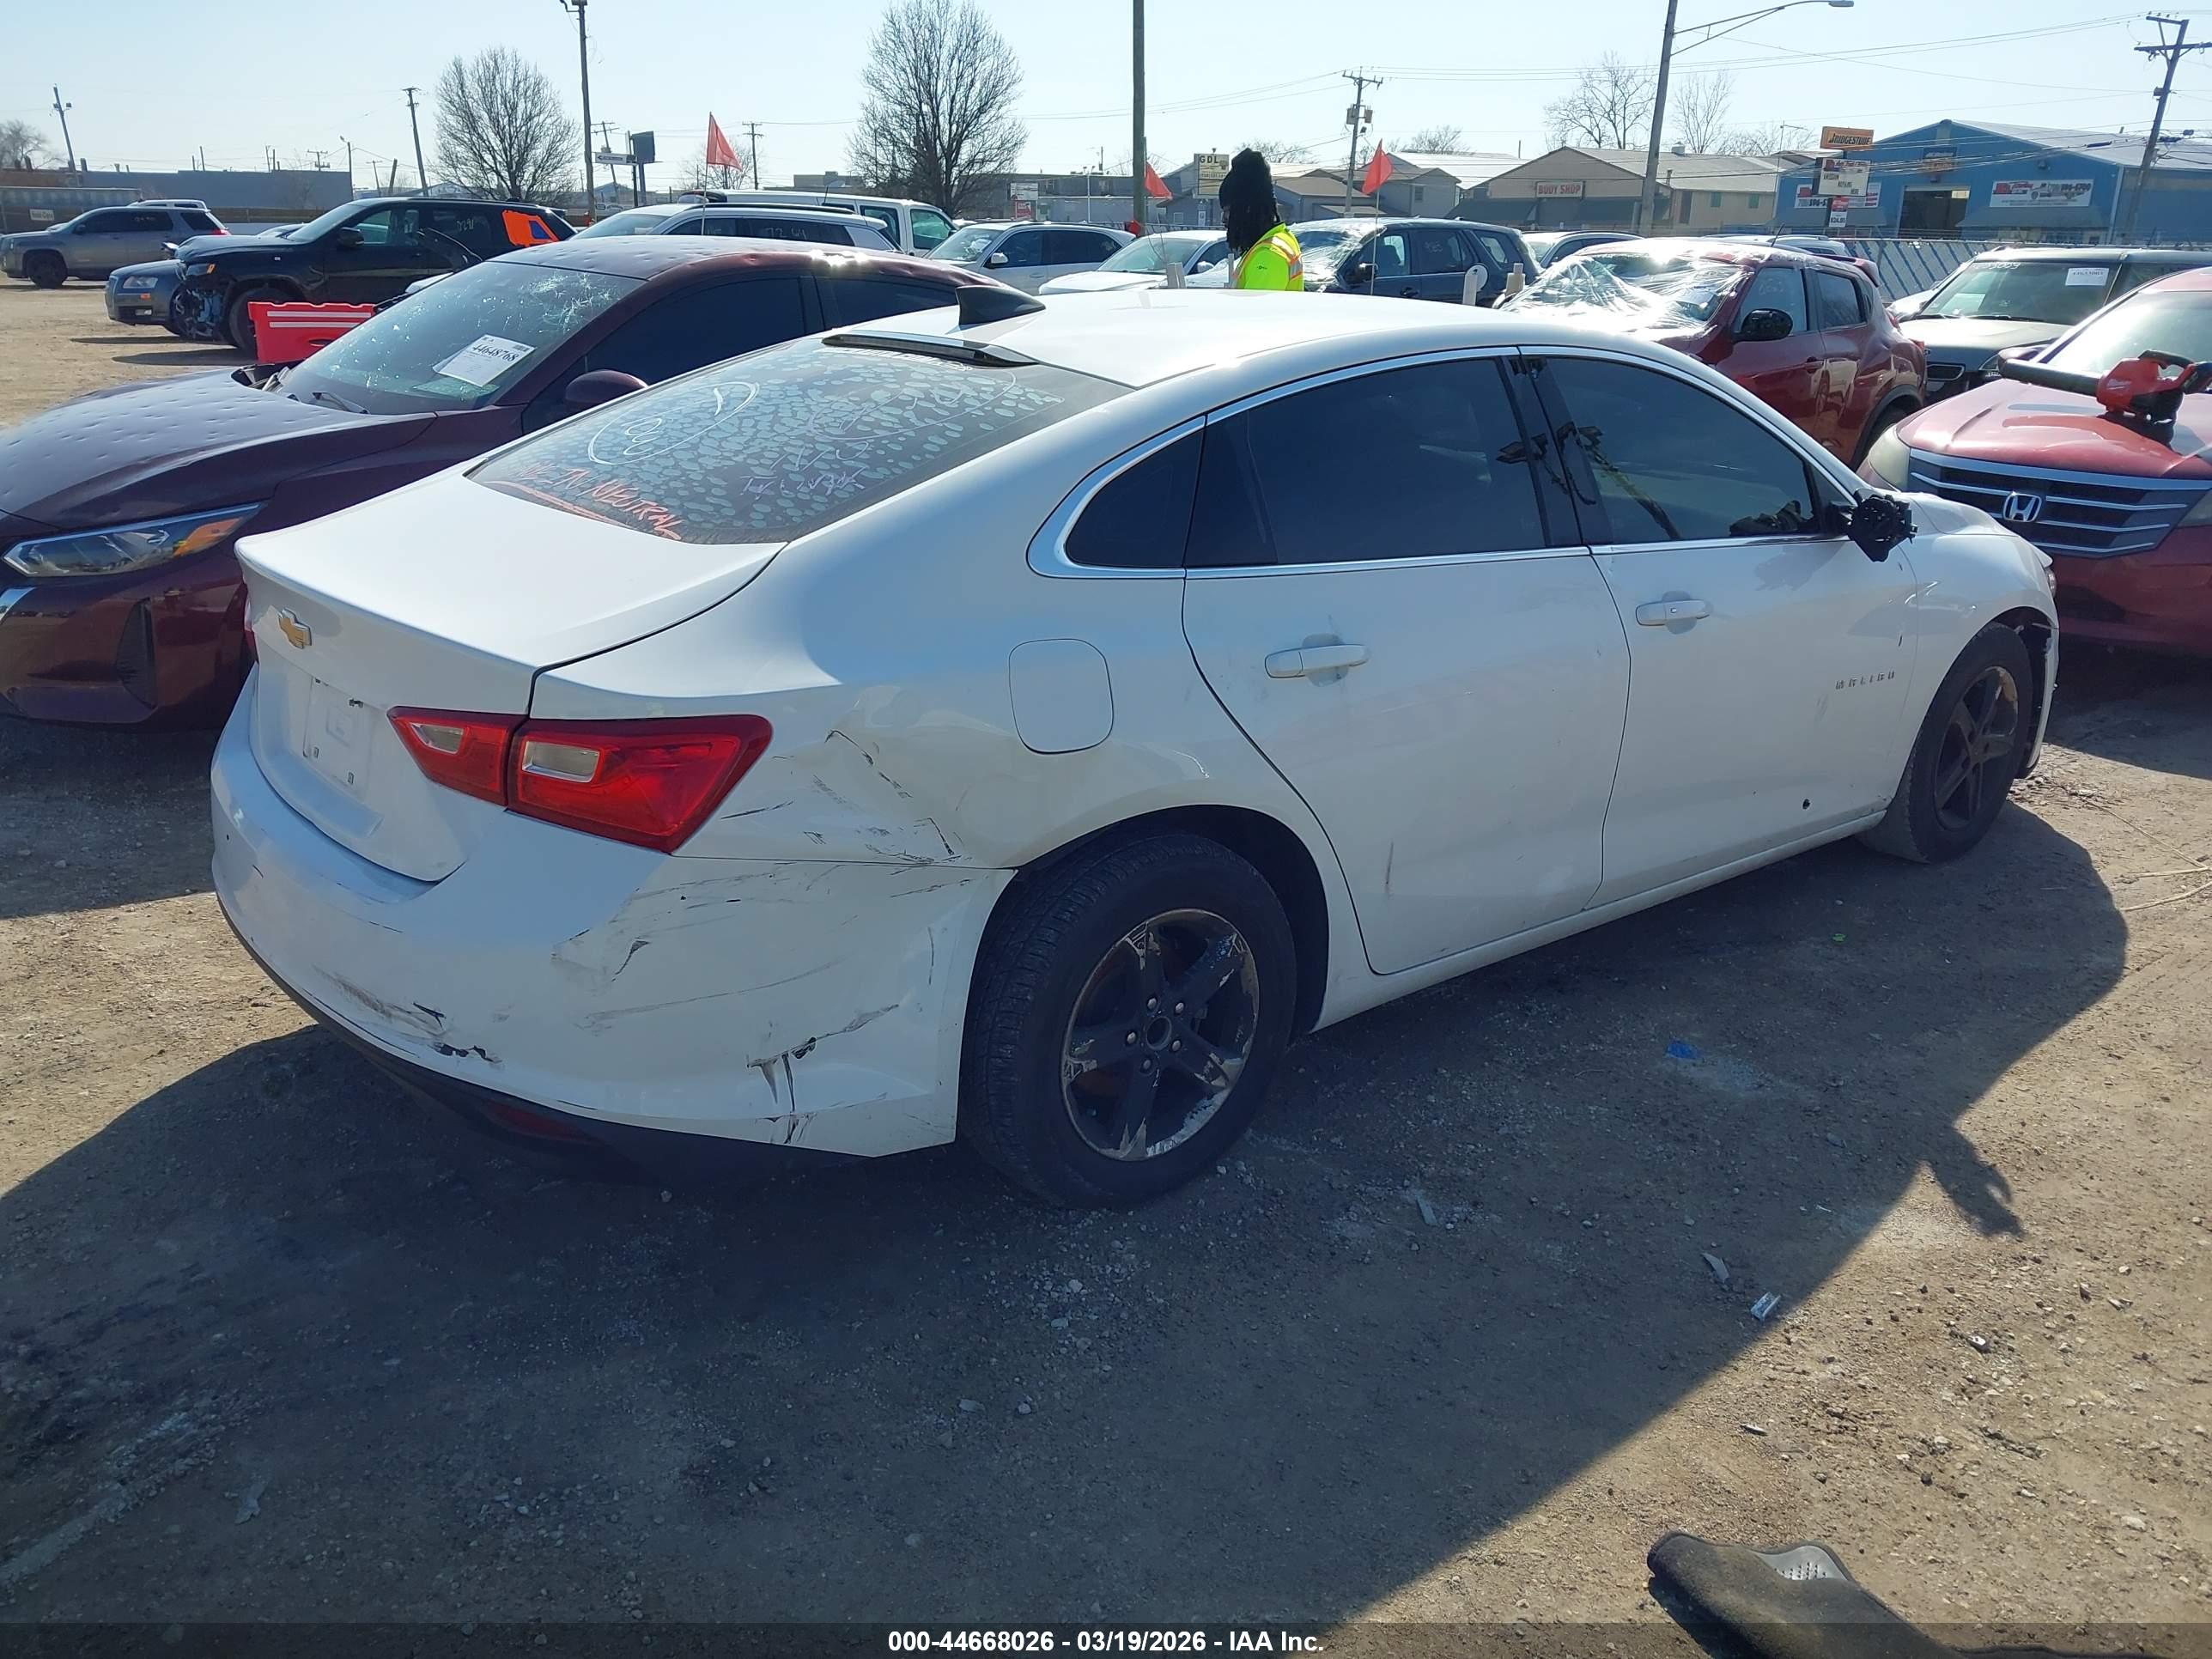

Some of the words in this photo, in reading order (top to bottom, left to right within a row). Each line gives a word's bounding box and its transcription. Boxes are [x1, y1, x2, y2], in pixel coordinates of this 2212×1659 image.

[1200, 155, 1219, 164] GDL
[1538, 185, 1558, 195] BODY
[1560, 185, 1581, 194] SHOP
[472, 343, 520, 362] 44648768
[575, 478, 684, 541] NEUTRAL
[1835, 670, 1895, 690] MALIBU
